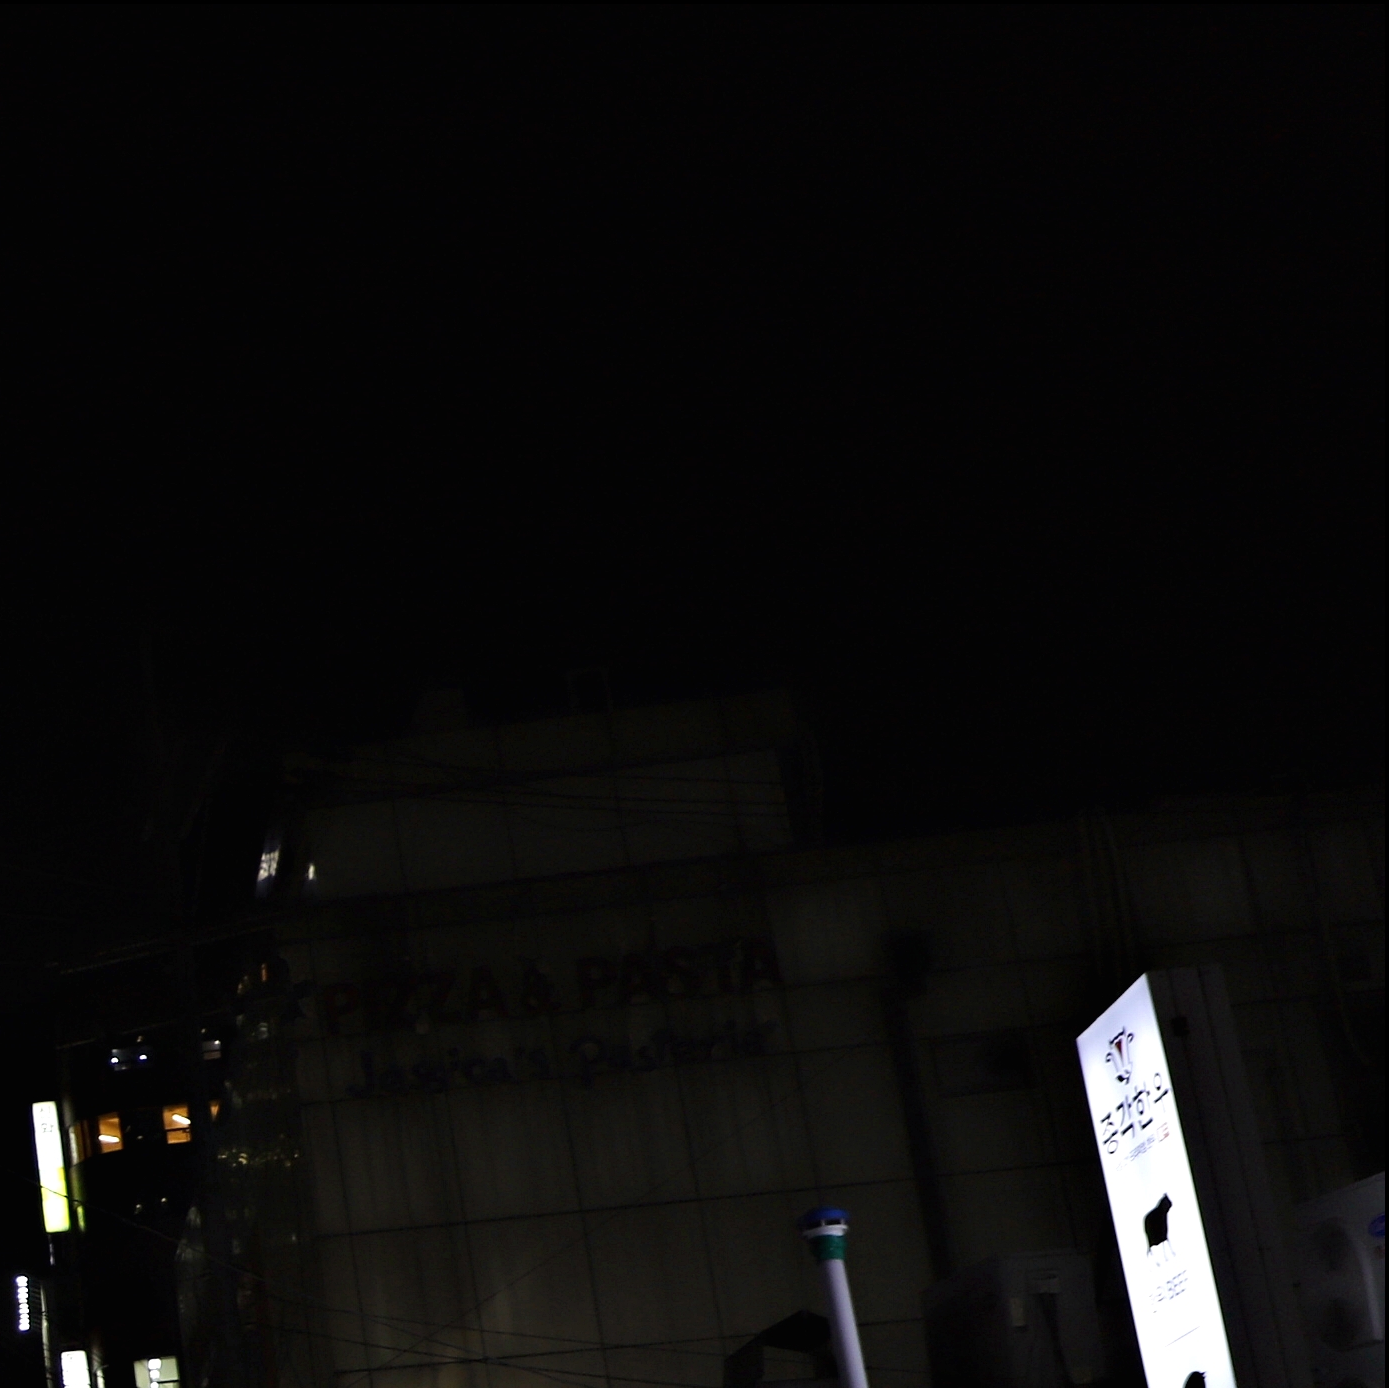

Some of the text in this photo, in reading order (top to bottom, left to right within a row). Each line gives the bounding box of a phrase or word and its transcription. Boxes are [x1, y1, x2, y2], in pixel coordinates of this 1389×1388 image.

[321, 935, 784, 1036] PIZZA & PASTA
[1100, 1071, 1172, 1155] 종각한우
